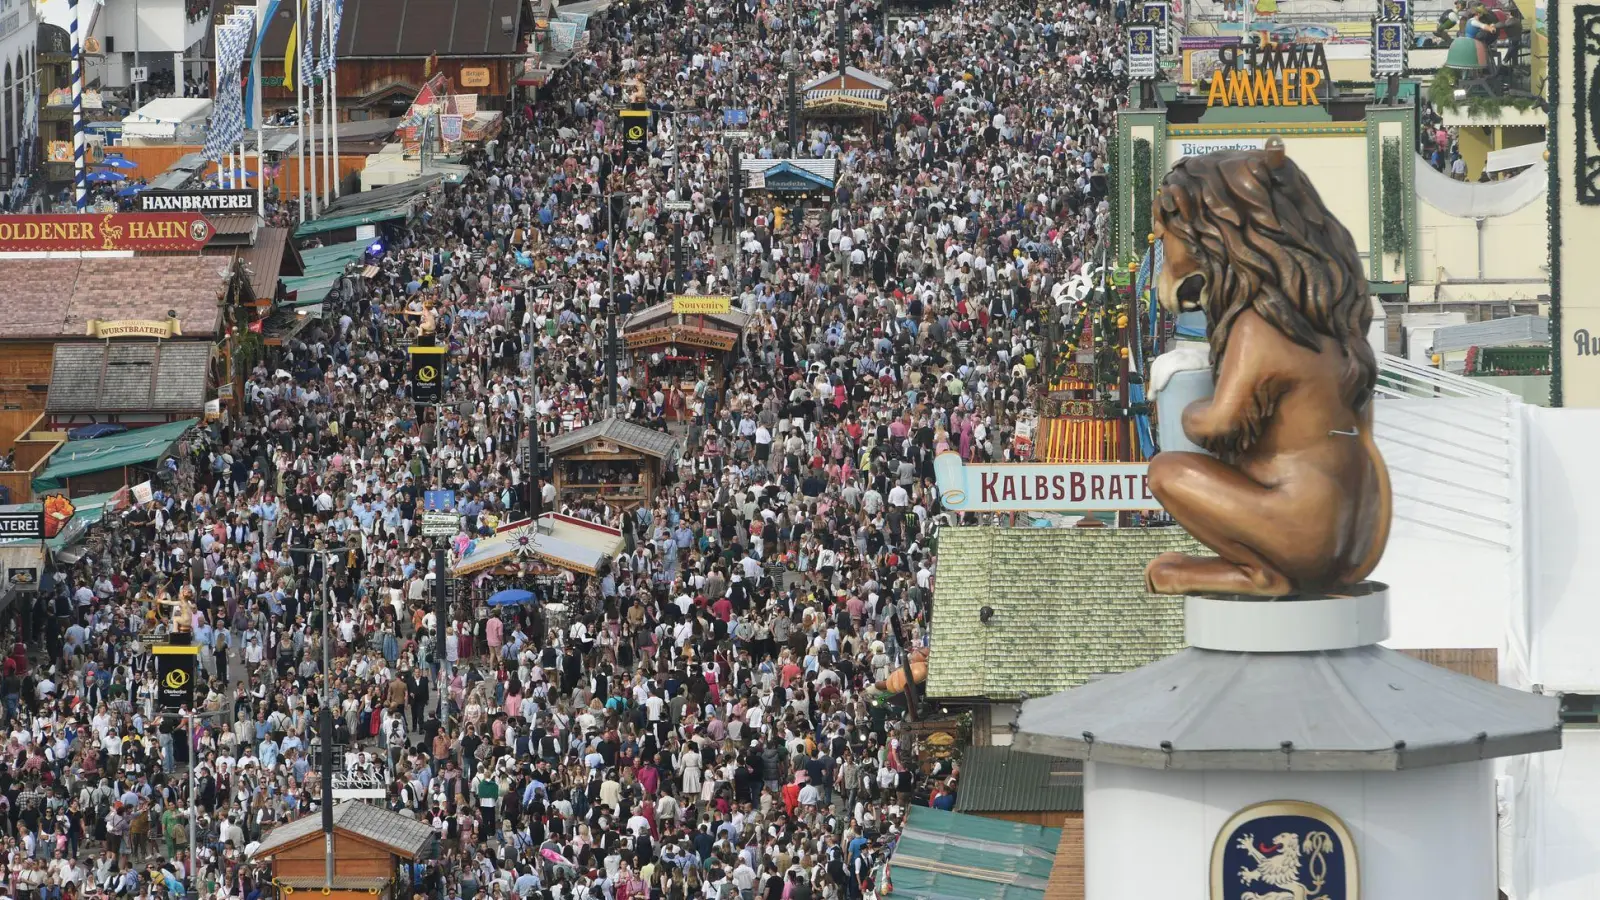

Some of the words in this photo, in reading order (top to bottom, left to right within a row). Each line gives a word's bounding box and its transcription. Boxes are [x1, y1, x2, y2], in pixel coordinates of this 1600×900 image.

[1207, 67, 1321, 107] AMMER
[142, 194, 253, 210] HAXNBRATEREI
[128, 221, 188, 239] HAHN
[678, 300, 724, 309] Souvenirs
[101, 326, 167, 336] WURSTBRATEREI
